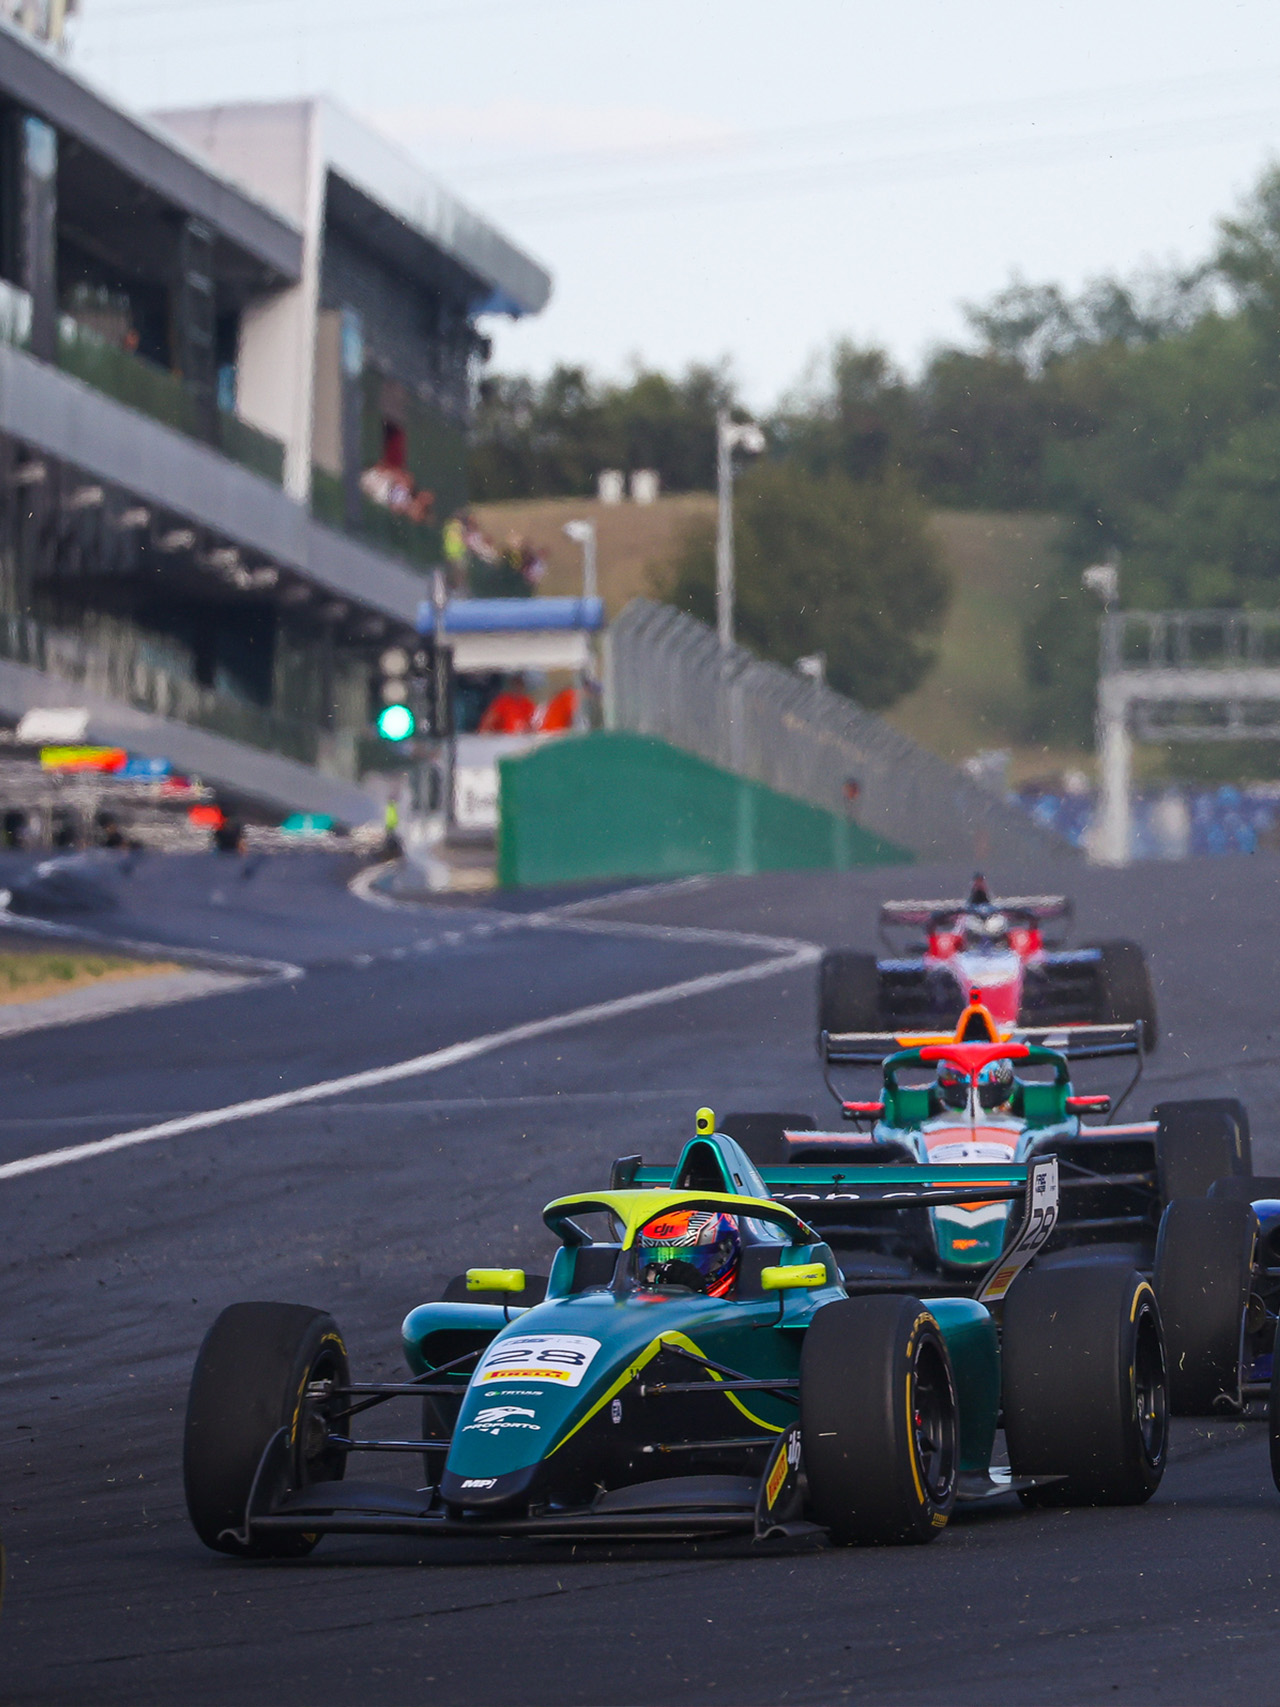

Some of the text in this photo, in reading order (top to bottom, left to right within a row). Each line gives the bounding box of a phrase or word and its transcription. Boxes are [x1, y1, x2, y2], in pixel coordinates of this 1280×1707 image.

[484, 1350, 586, 1367] 28
[490, 1370, 563, 1379] PIRELLI
[462, 1422, 541, 1432] PROFORTO
